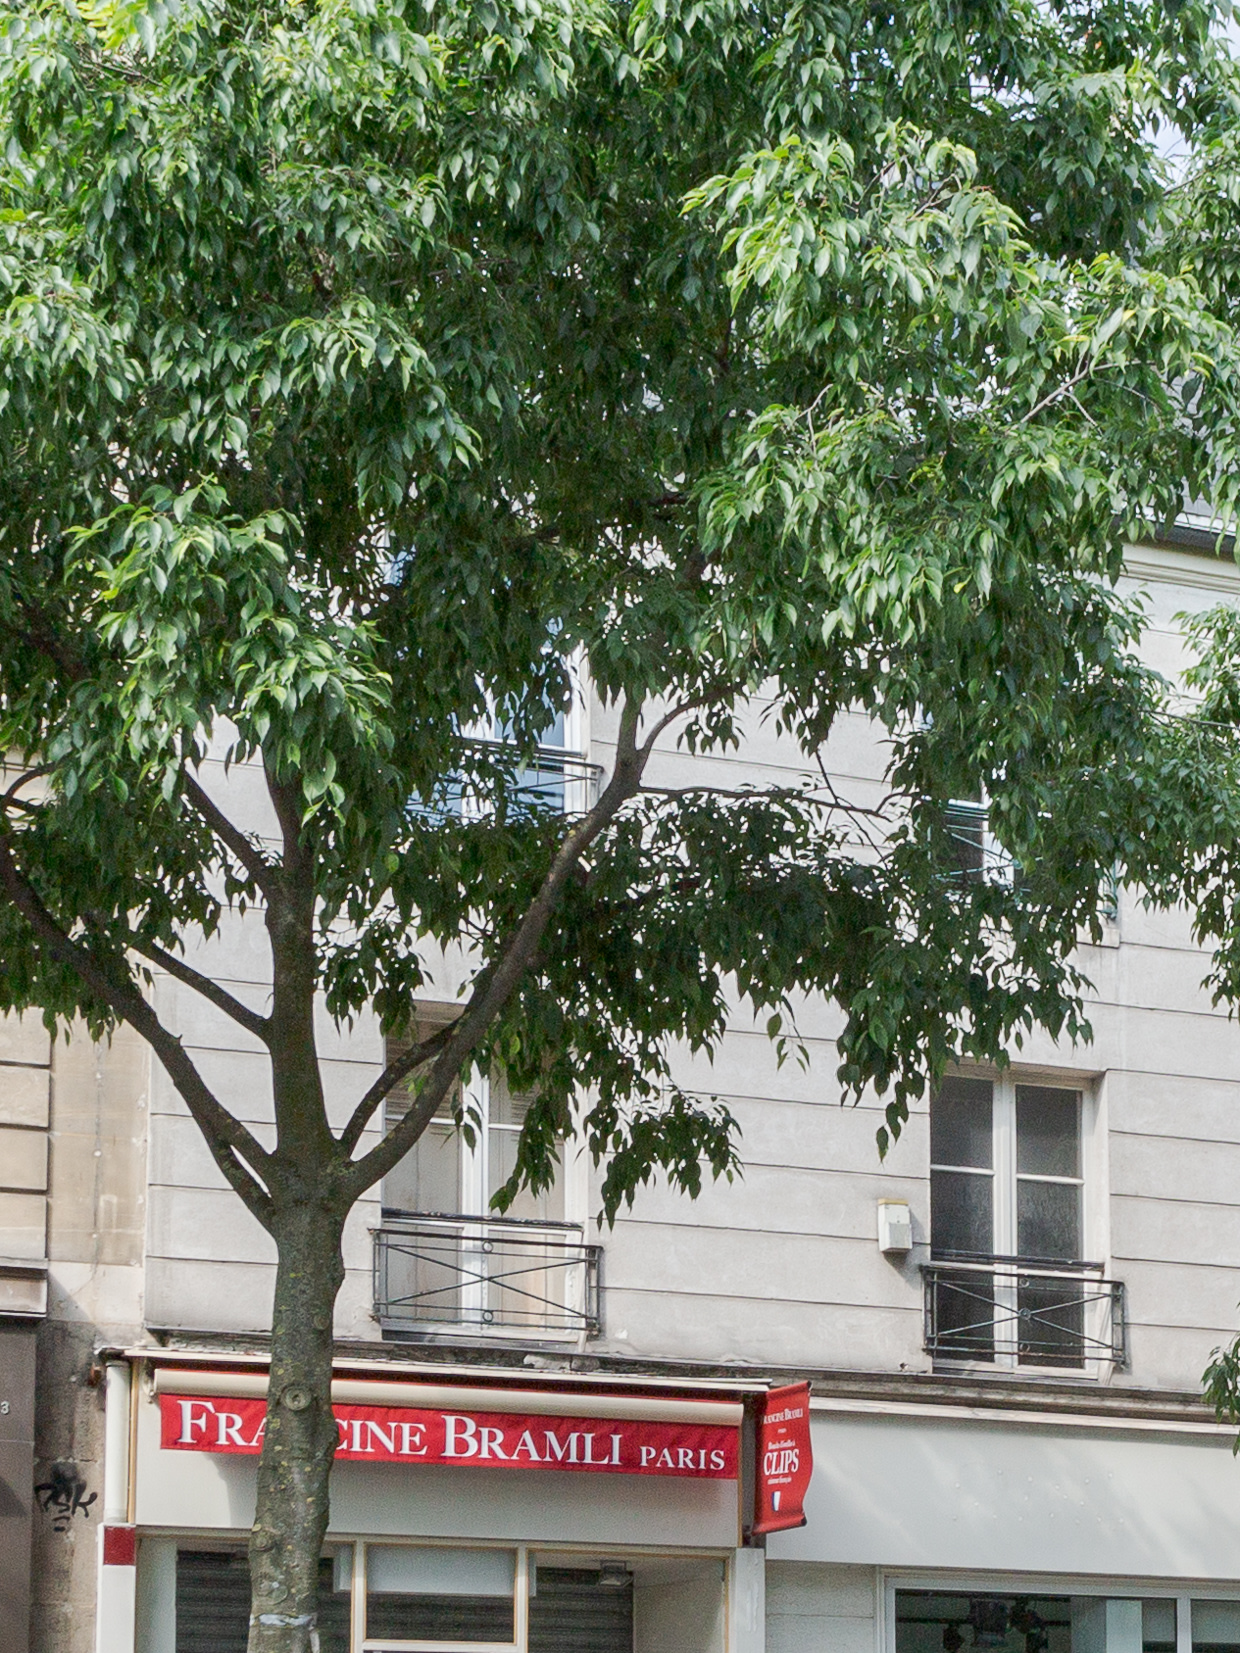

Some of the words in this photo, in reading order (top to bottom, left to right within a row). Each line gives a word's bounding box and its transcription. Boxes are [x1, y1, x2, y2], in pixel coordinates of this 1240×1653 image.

[176, 1400, 427, 1456] FRAINE
[440, 1415, 623, 1466] BRAMLI
[639, 1446, 725, 1471] PARIS
[763, 1448, 800, 1476] CLIPS
